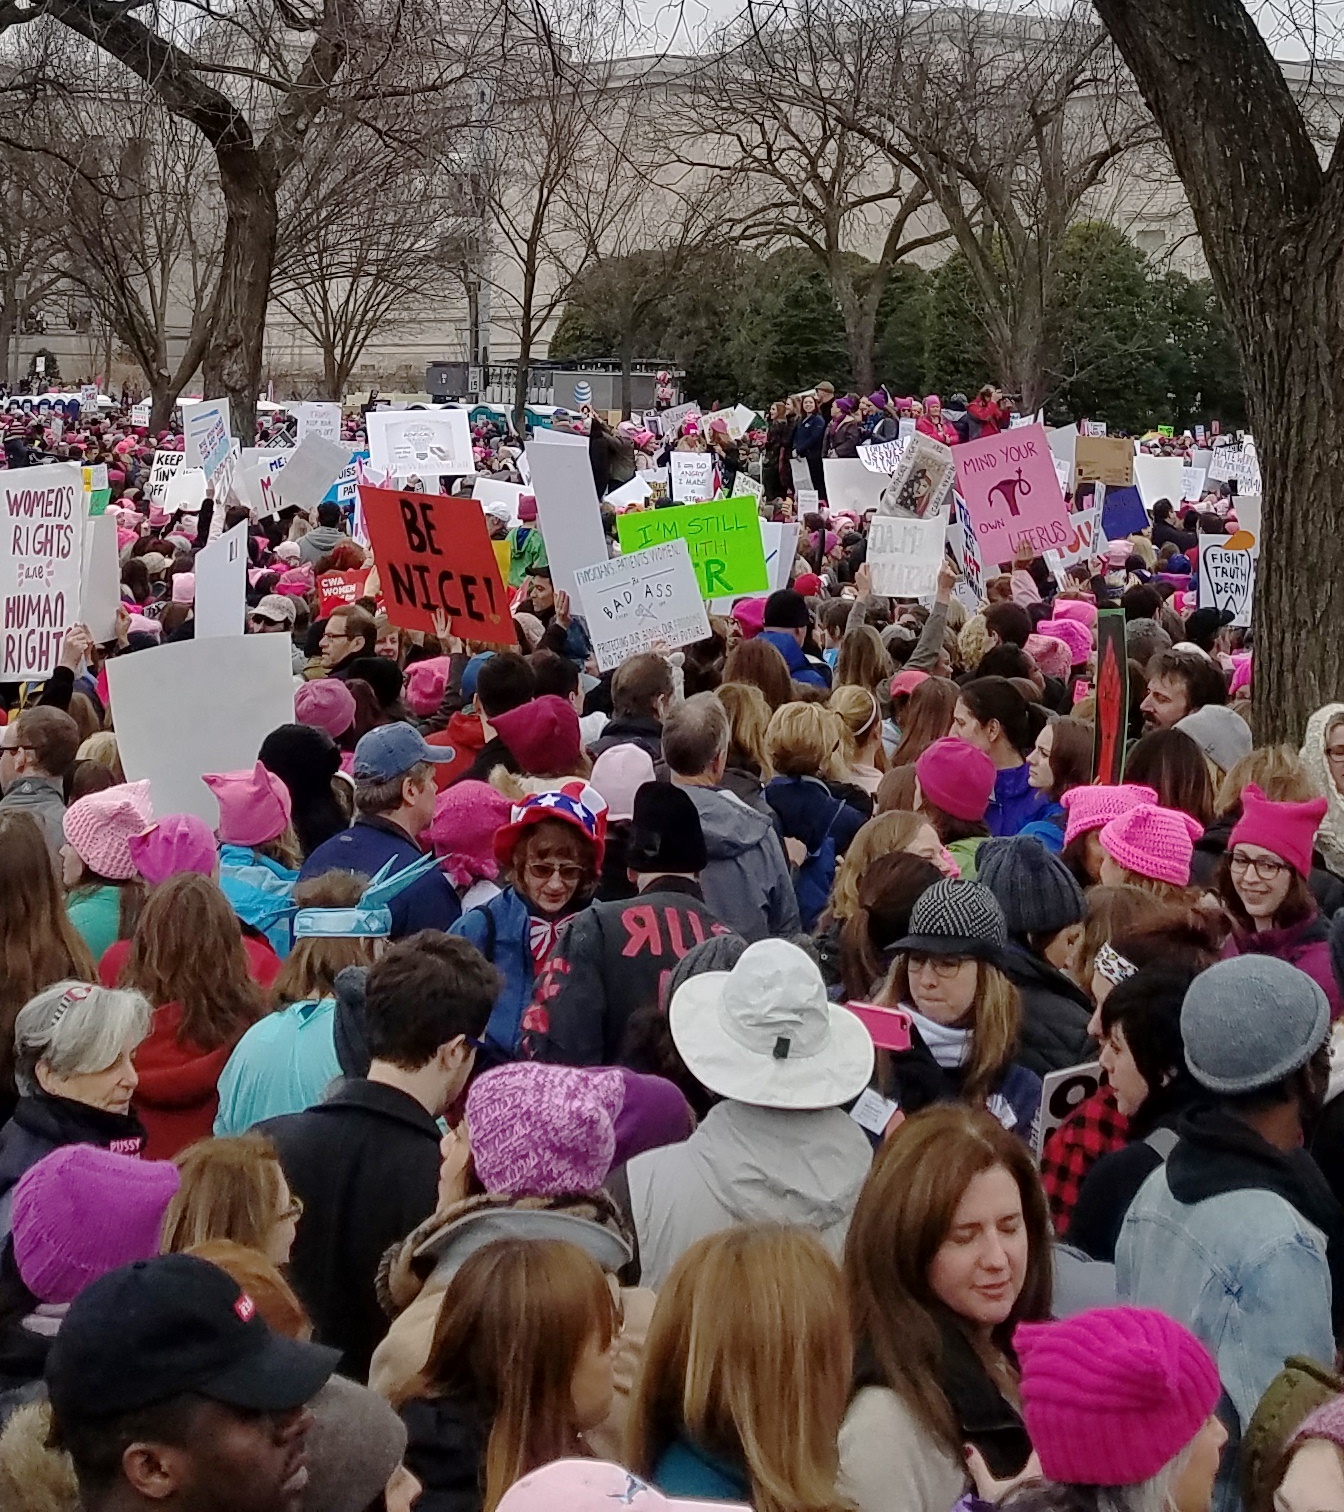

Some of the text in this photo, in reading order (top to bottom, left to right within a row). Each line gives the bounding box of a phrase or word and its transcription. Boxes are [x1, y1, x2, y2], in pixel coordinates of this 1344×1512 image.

[157, 453, 184, 466] KEEP
[963, 441, 1039, 476] MIND YOUR
[4, 485, 74, 521] WOMEN'S
[399, 498, 444, 557] BE
[687, 515, 749, 536] STILL
[979, 518, 1006, 535] OWN
[1008, 520, 1068, 554] UTERUS
[12, 522, 74, 560] RIGHTS
[1211, 552, 1246, 566] FIGHT
[320, 575, 345, 587] CWA
[1212, 566, 1247, 581] TRUTH
[322, 584, 356, 596] WOMEN
[388, 562, 500, 624] NICE!
[602, 583, 674, 620] BAD ASS
[1214, 582, 1246, 597] DECAY
[3, 590, 65, 630] HUMAN
[3, 626, 69, 674] RIGHT
[109, 1137, 141, 1153] PUSSY
